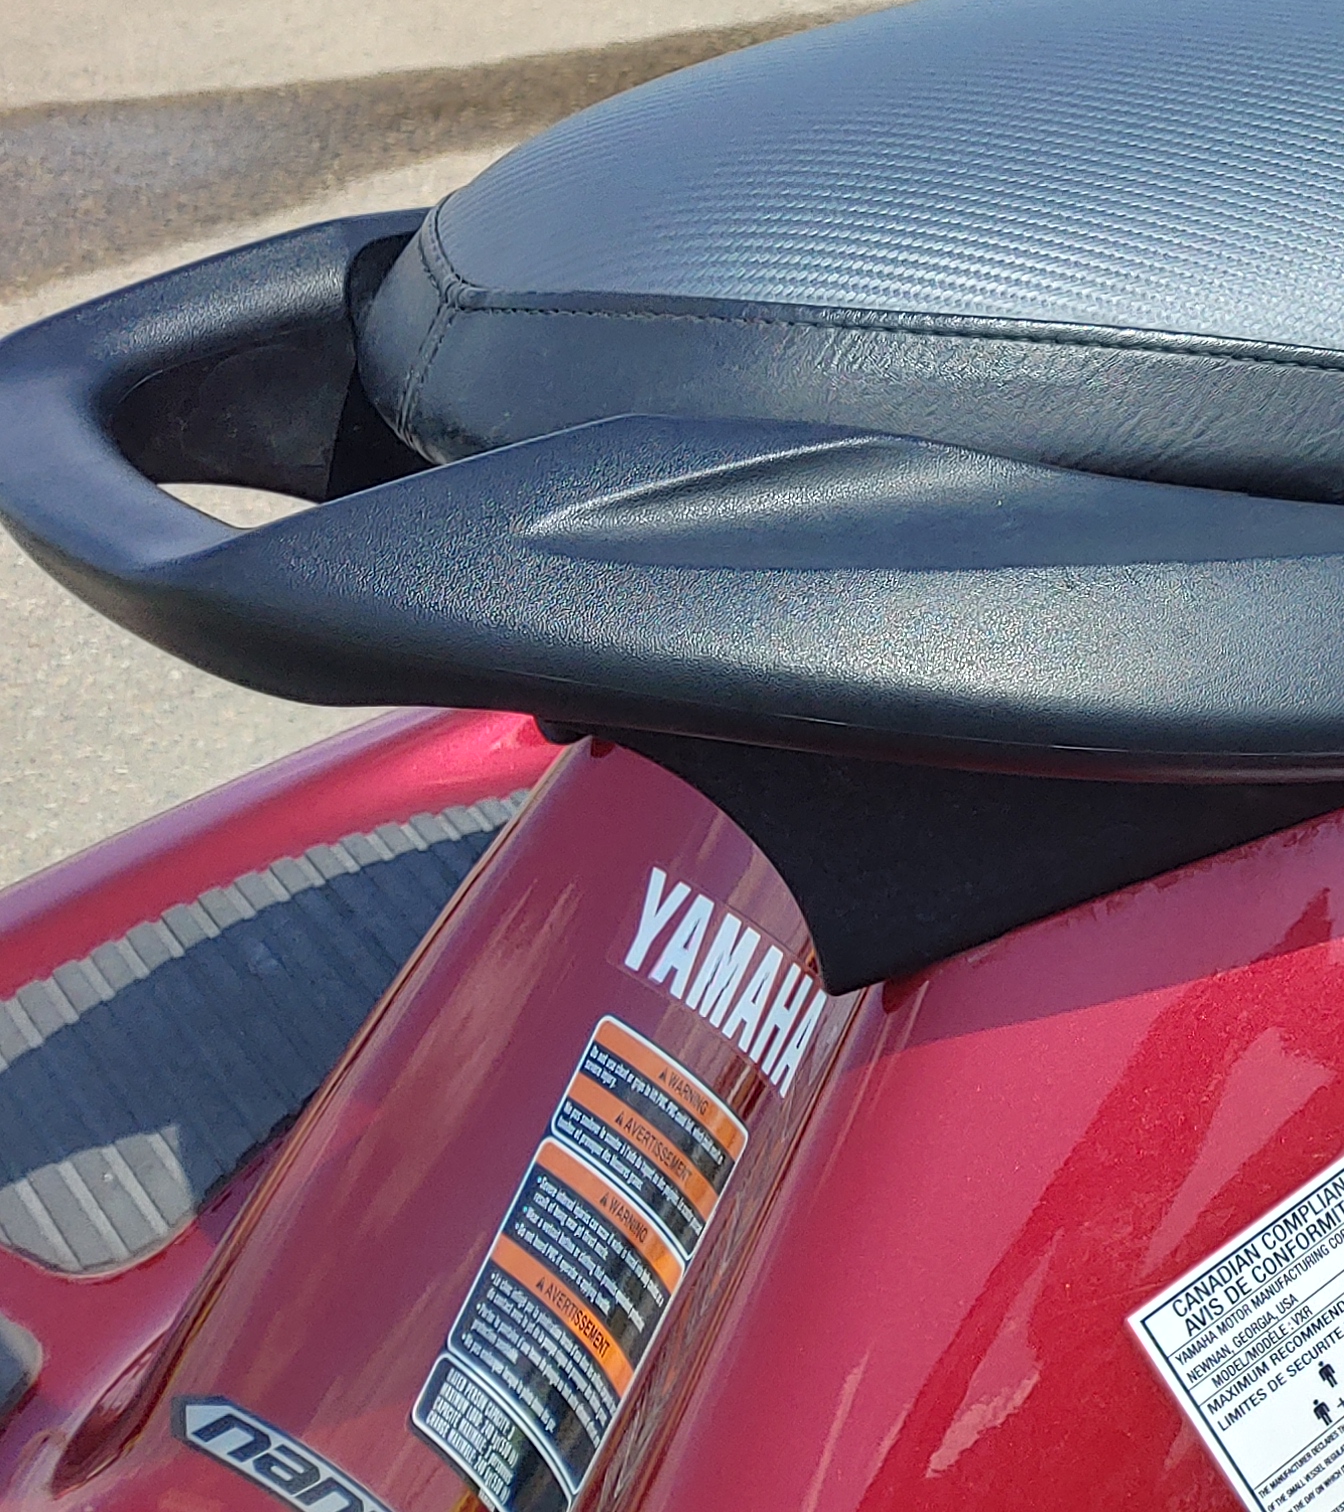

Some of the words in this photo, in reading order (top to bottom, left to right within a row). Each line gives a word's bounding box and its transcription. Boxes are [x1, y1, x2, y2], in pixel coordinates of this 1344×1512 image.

[624, 866, 828, 1099] YAMAHA
[668, 1072, 709, 1116] WARNING
[623, 1118, 692, 1185] AVERTISSEMENT
[609, 1199, 648, 1243] WARNING
[1172, 1243, 1262, 1318] CANADIAN
[1174, 1330, 1219, 1366] YAMAHA
[1215, 1303, 1253, 1336] MOTOR
[1250, 1244, 1330, 1310] MANUFACTURING
[1185, 1297, 1225, 1337] AVIS
[1223, 1275, 1253, 1305] DE
[545, 1283, 610, 1357] AVERTISSEMENT
[1186, 1344, 1236, 1384] NEWNAN,
[1232, 1311, 1279, 1348] GEORGIA,
[1275, 1293, 1299, 1315] USA
[1290, 1305, 1313, 1326] VXR
[1206, 1361, 1270, 1415] MAXIMUM
[1217, 1387, 1268, 1432] LIMITES
[1266, 1372, 1287, 1393] DE
[1285, 1326, 1344, 1378] SECURITE
[1257, 1485, 1272, 1499] THE
[1274, 1493, 1288, 1507] THE
[1303, 1490, 1316, 1505] DAY
